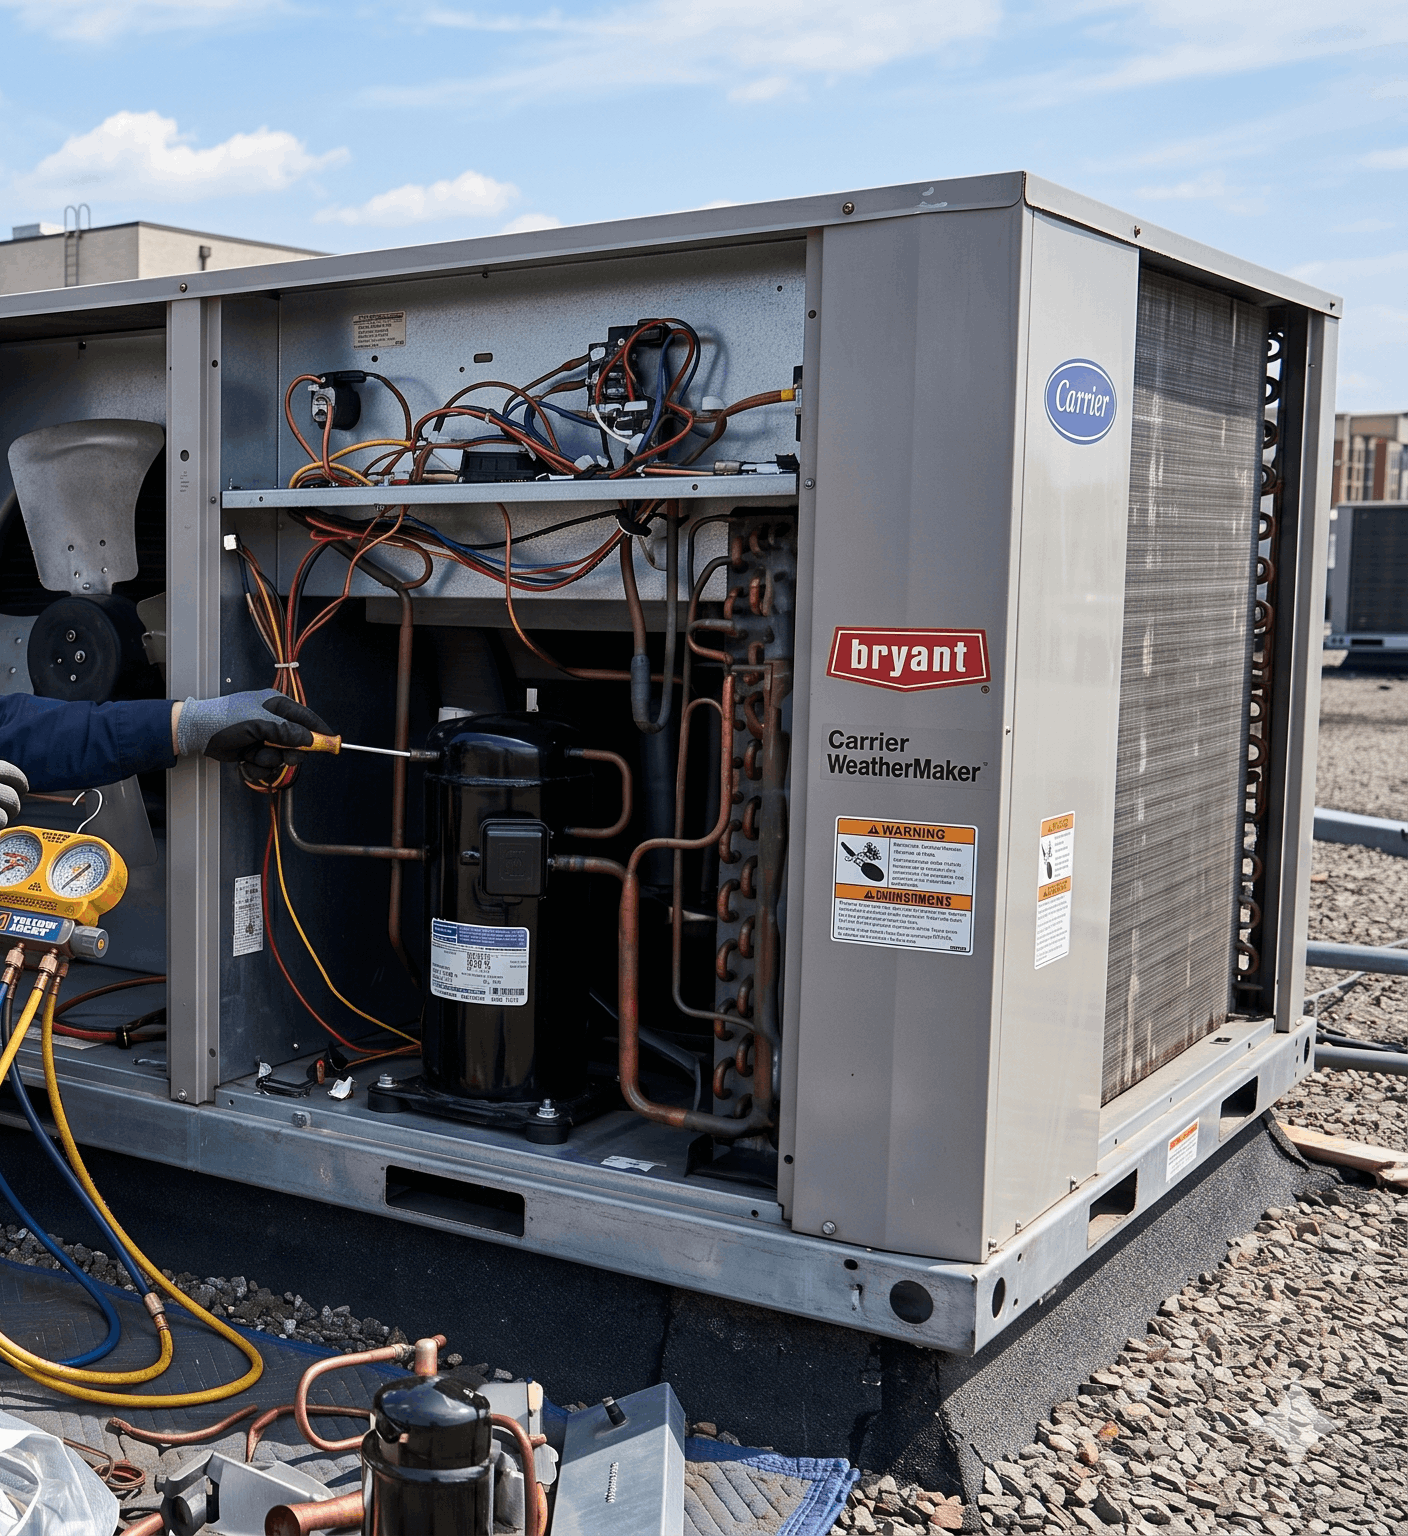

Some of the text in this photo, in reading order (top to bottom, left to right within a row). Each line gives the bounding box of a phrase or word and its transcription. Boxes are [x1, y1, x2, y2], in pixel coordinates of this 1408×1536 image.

[1055, 379, 1110, 418] Carrier
[850, 638, 968, 678] bryant
[828, 729, 910, 753] Carrier
[827, 753, 981, 782] WeatherMaker
[882, 823, 946, 840] WARNING
